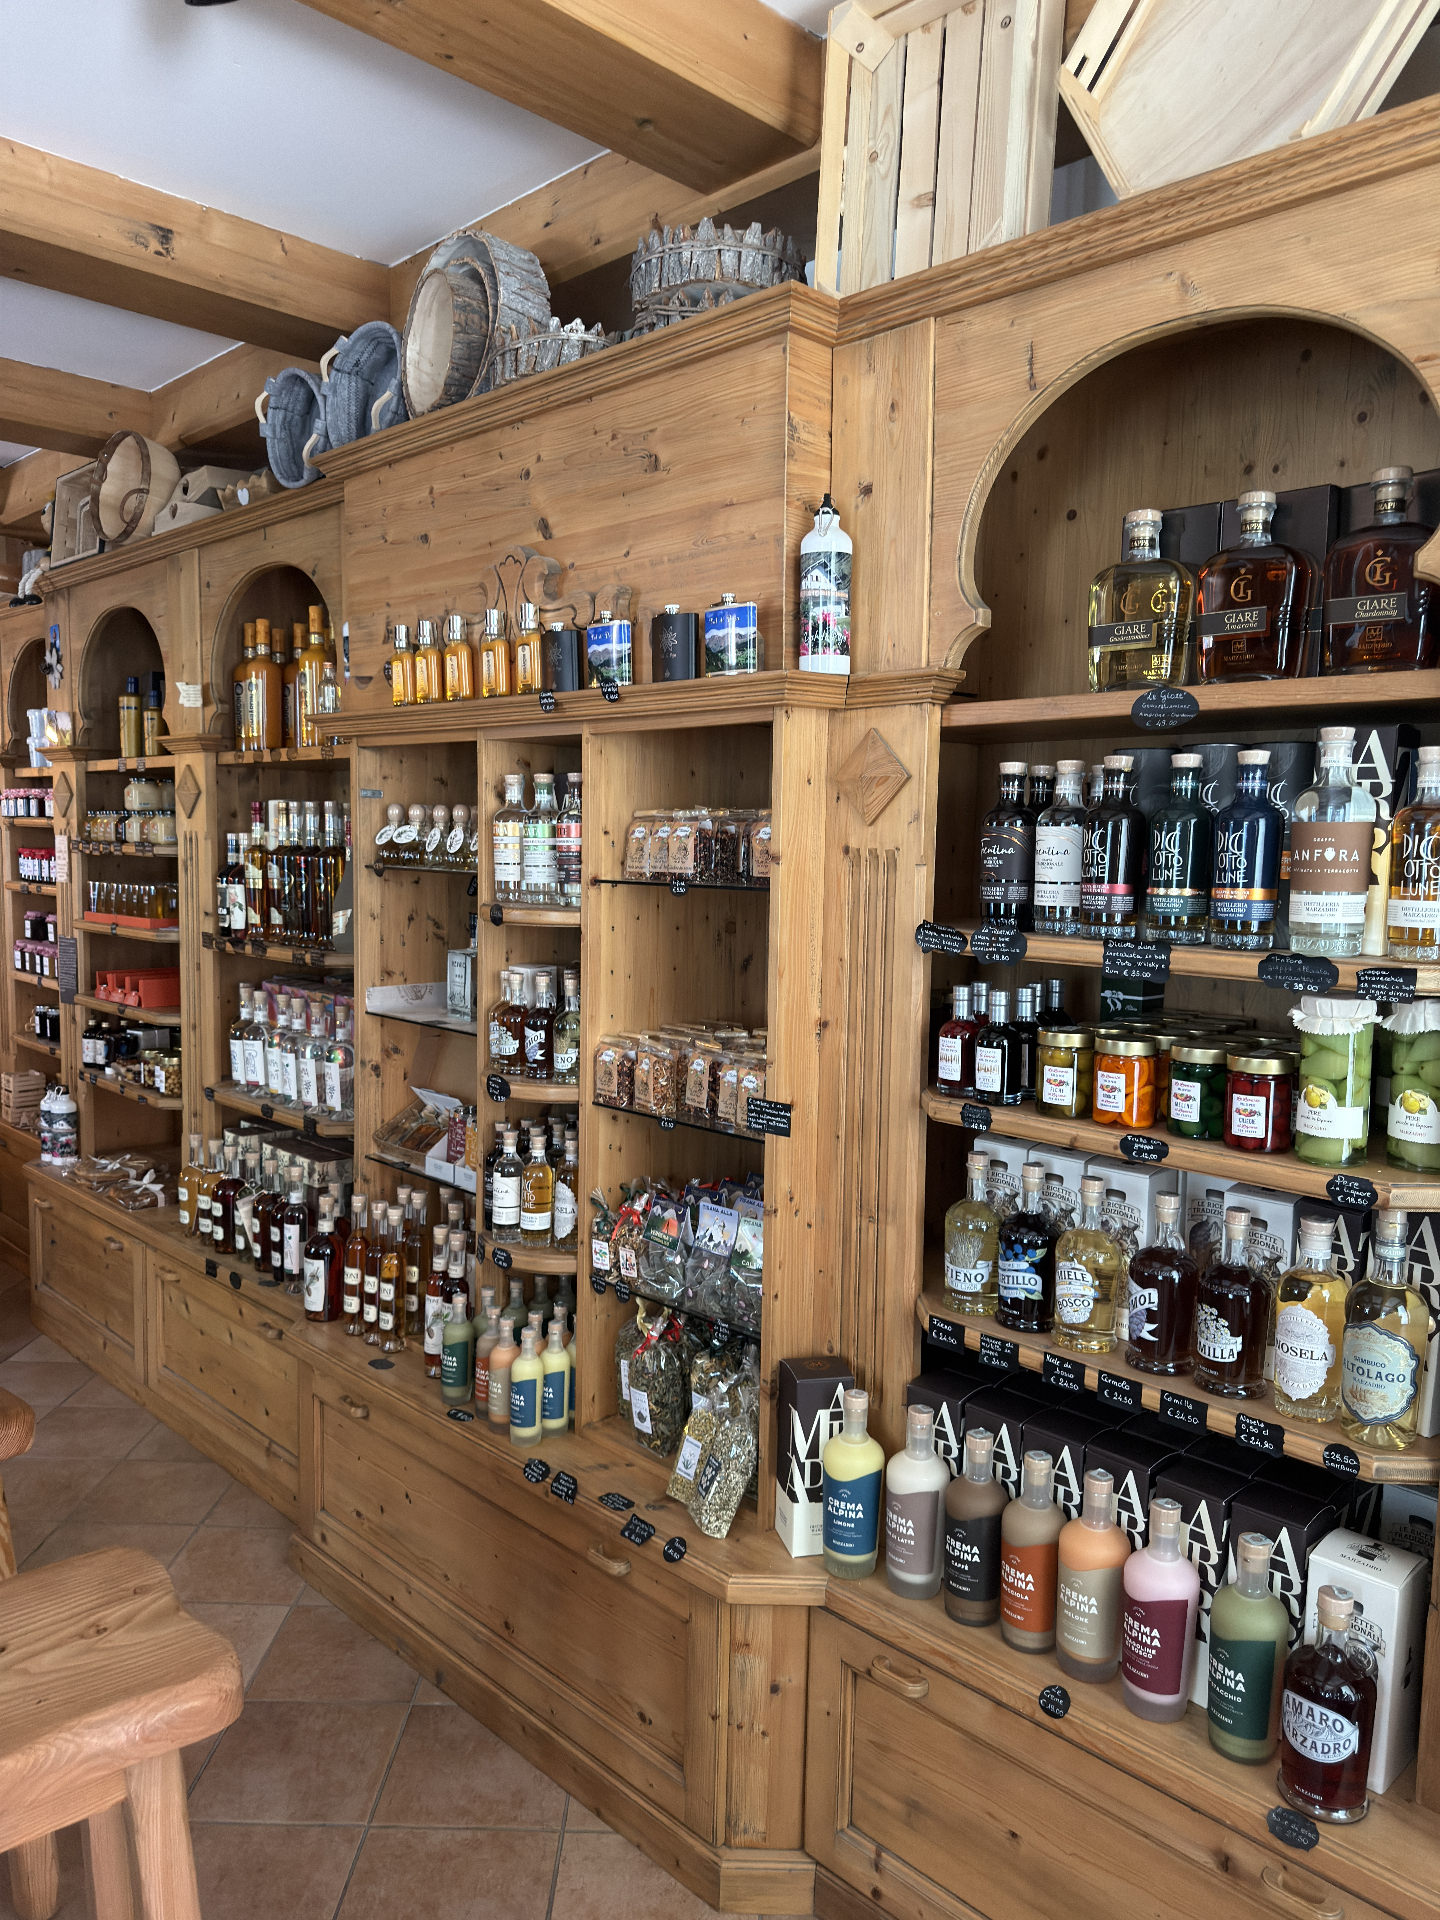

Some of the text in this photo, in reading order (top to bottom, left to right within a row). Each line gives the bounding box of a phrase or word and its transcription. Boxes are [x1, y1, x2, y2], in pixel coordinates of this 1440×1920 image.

[1357, 597, 1397, 611] GIARE
[1224, 610, 1259, 623] GIARE
[1354, 608, 1398, 619] Chardonnay
[1114, 623, 1147, 636] GIARE
[1224, 621, 1258, 631] Amarone
[1084, 849, 1107, 864] OTTO
[1154, 851, 1183, 867] OTTO
[1218, 853, 1248, 870] OTTO
[1081, 865, 1107, 878] LUNE
[1152, 868, 1184, 881] LUNE
[1215, 870, 1249, 884] LUNE
[1123, 969, 1129, 977] €
[1307, 1109, 1322, 1117] PERE
[1405, 1114, 1421, 1122] PERE
[990, 1171, 1016, 1183] RICETTE
[1046, 1184, 1072, 1197] RICETTE
[1197, 1200, 1206, 1208] LE
[1337, 1194, 1345, 1203] €
[1105, 1201, 1135, 1214] RICETTE
[946, 1266, 985, 1283] FIENO
[1057, 1298, 1091, 1311] BOSCO
[1343, 1356, 1406, 1383] ALTOLAGO
[1353, 1355, 1387, 1369] SAMBUCO
[1050, 1375, 1056, 1385] €
[1100, 1373, 1131, 1391] Cirmolo
[1352, 1376, 1386, 1389] MARZADRO
[1103, 1388, 1133, 1405] € 24.50
[1167, 1407, 1200, 1425] € 24.50
[1240, 1433, 1248, 1443] €
[1323, 1451, 1330, 1459] €
[828, 1496, 864, 1511] CREMA
[827, 1504, 864, 1519] ALPINA
[887, 1507, 914, 1528] CREMA
[833, 1518, 855, 1528] LIMONE
[897, 1537, 915, 1546] LATTE
[946, 1534, 980, 1554] CREMA
[945, 1542, 981, 1563] ALPINA
[951, 1560, 969, 1571] CAFFÈ
[1339, 1552, 1383, 1573] MARZADRO
[1001, 1560, 1034, 1583] CREMA
[1001, 1569, 1035, 1592] ALPINA
[1002, 1583, 1030, 1601] NOCCIOLA
[1060, 1583, 1098, 1606] CREMA
[1059, 1592, 1099, 1615] ALPINA
[1064, 1609, 1089, 1624] MELONE
[1124, 1611, 1161, 1639] CREMA
[1123, 1620, 1162, 1648] ALPINA
[1124, 1633, 1157, 1655] FRAGOLINE
[1131, 1645, 1153, 1659] BOSCO
[1209, 1653, 1245, 1683] CREMA
[1209, 1662, 1246, 1693] ALPINA
[1043, 1689, 1064, 1706] Creme
[1051, 1685, 1062, 1697] Le
[1285, 1693, 1345, 1734] AMARO
[1294, 1783, 1323, 1801] MARZADRO
